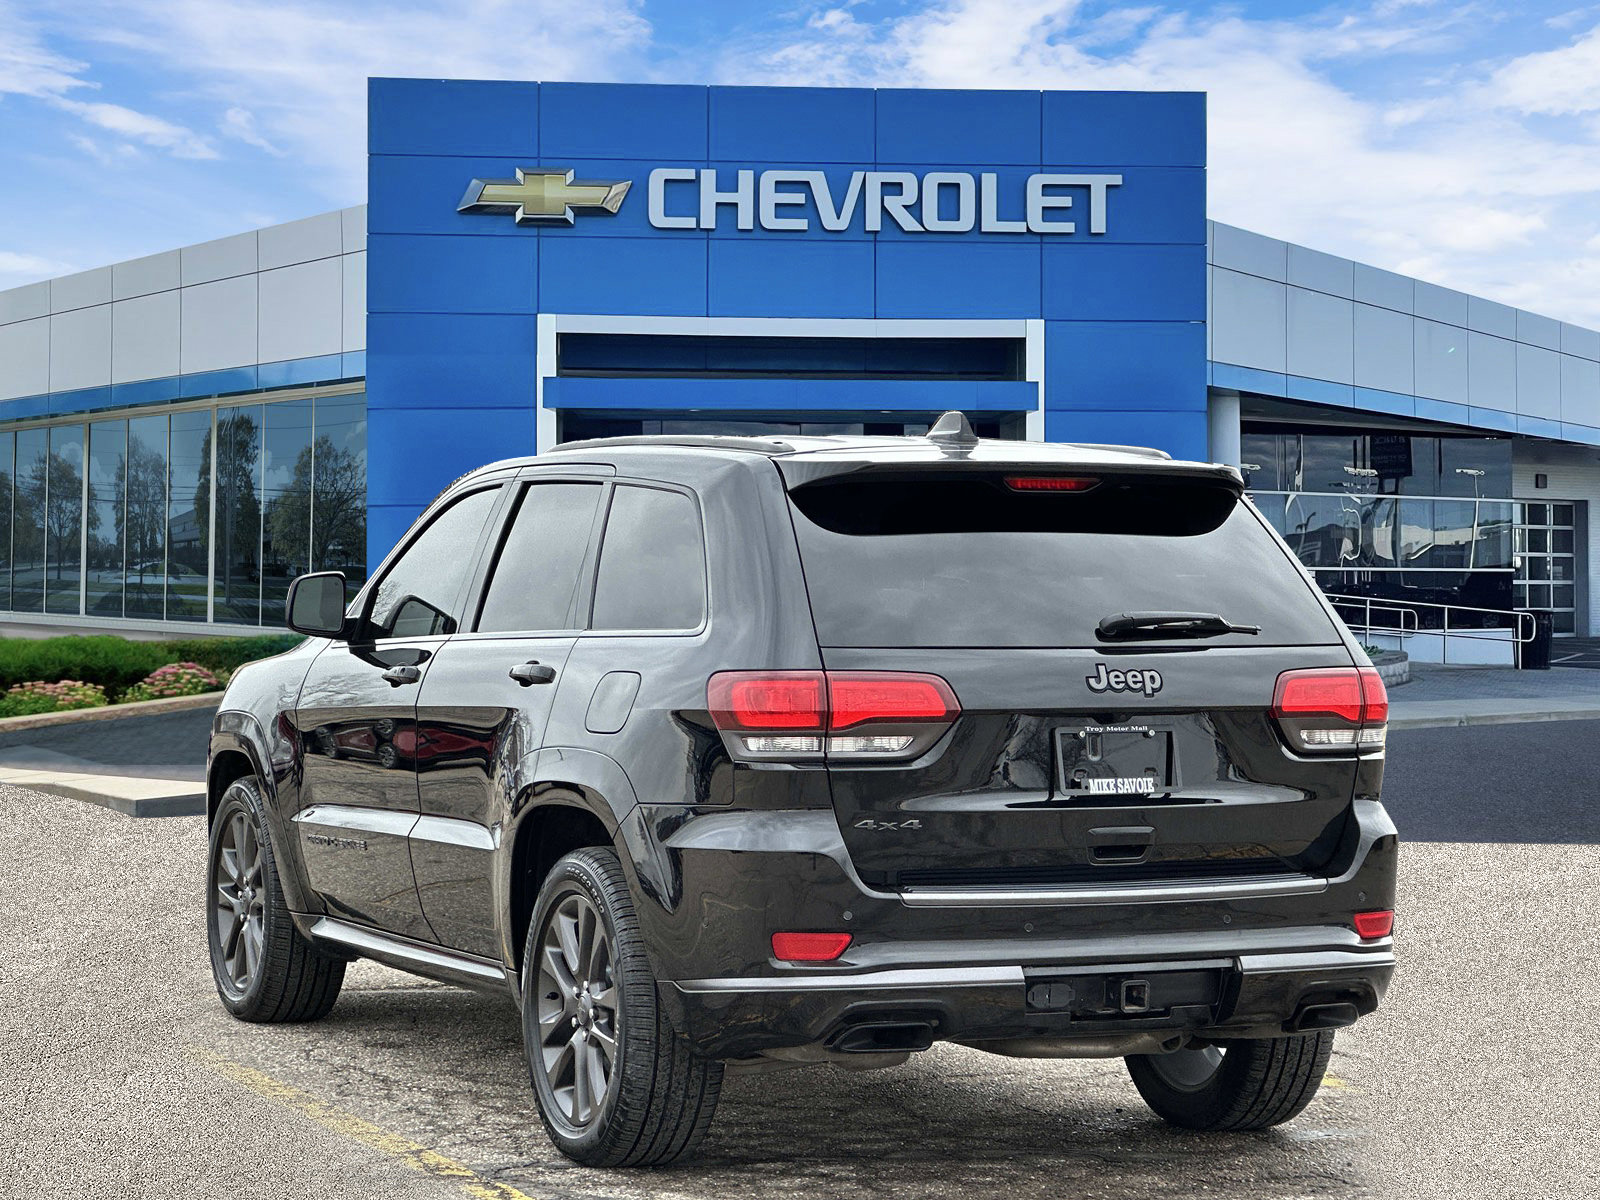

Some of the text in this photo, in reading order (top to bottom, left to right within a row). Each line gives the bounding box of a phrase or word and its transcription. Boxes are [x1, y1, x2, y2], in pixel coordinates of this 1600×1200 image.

[648, 168, 1123, 235] CHEVROLET
[1086, 663, 1163, 697] Jeep
[1084, 725, 1104, 733] Troy
[1088, 777, 1155, 794] MIKE SAVOIE
[854, 819, 922, 832] 4x4
